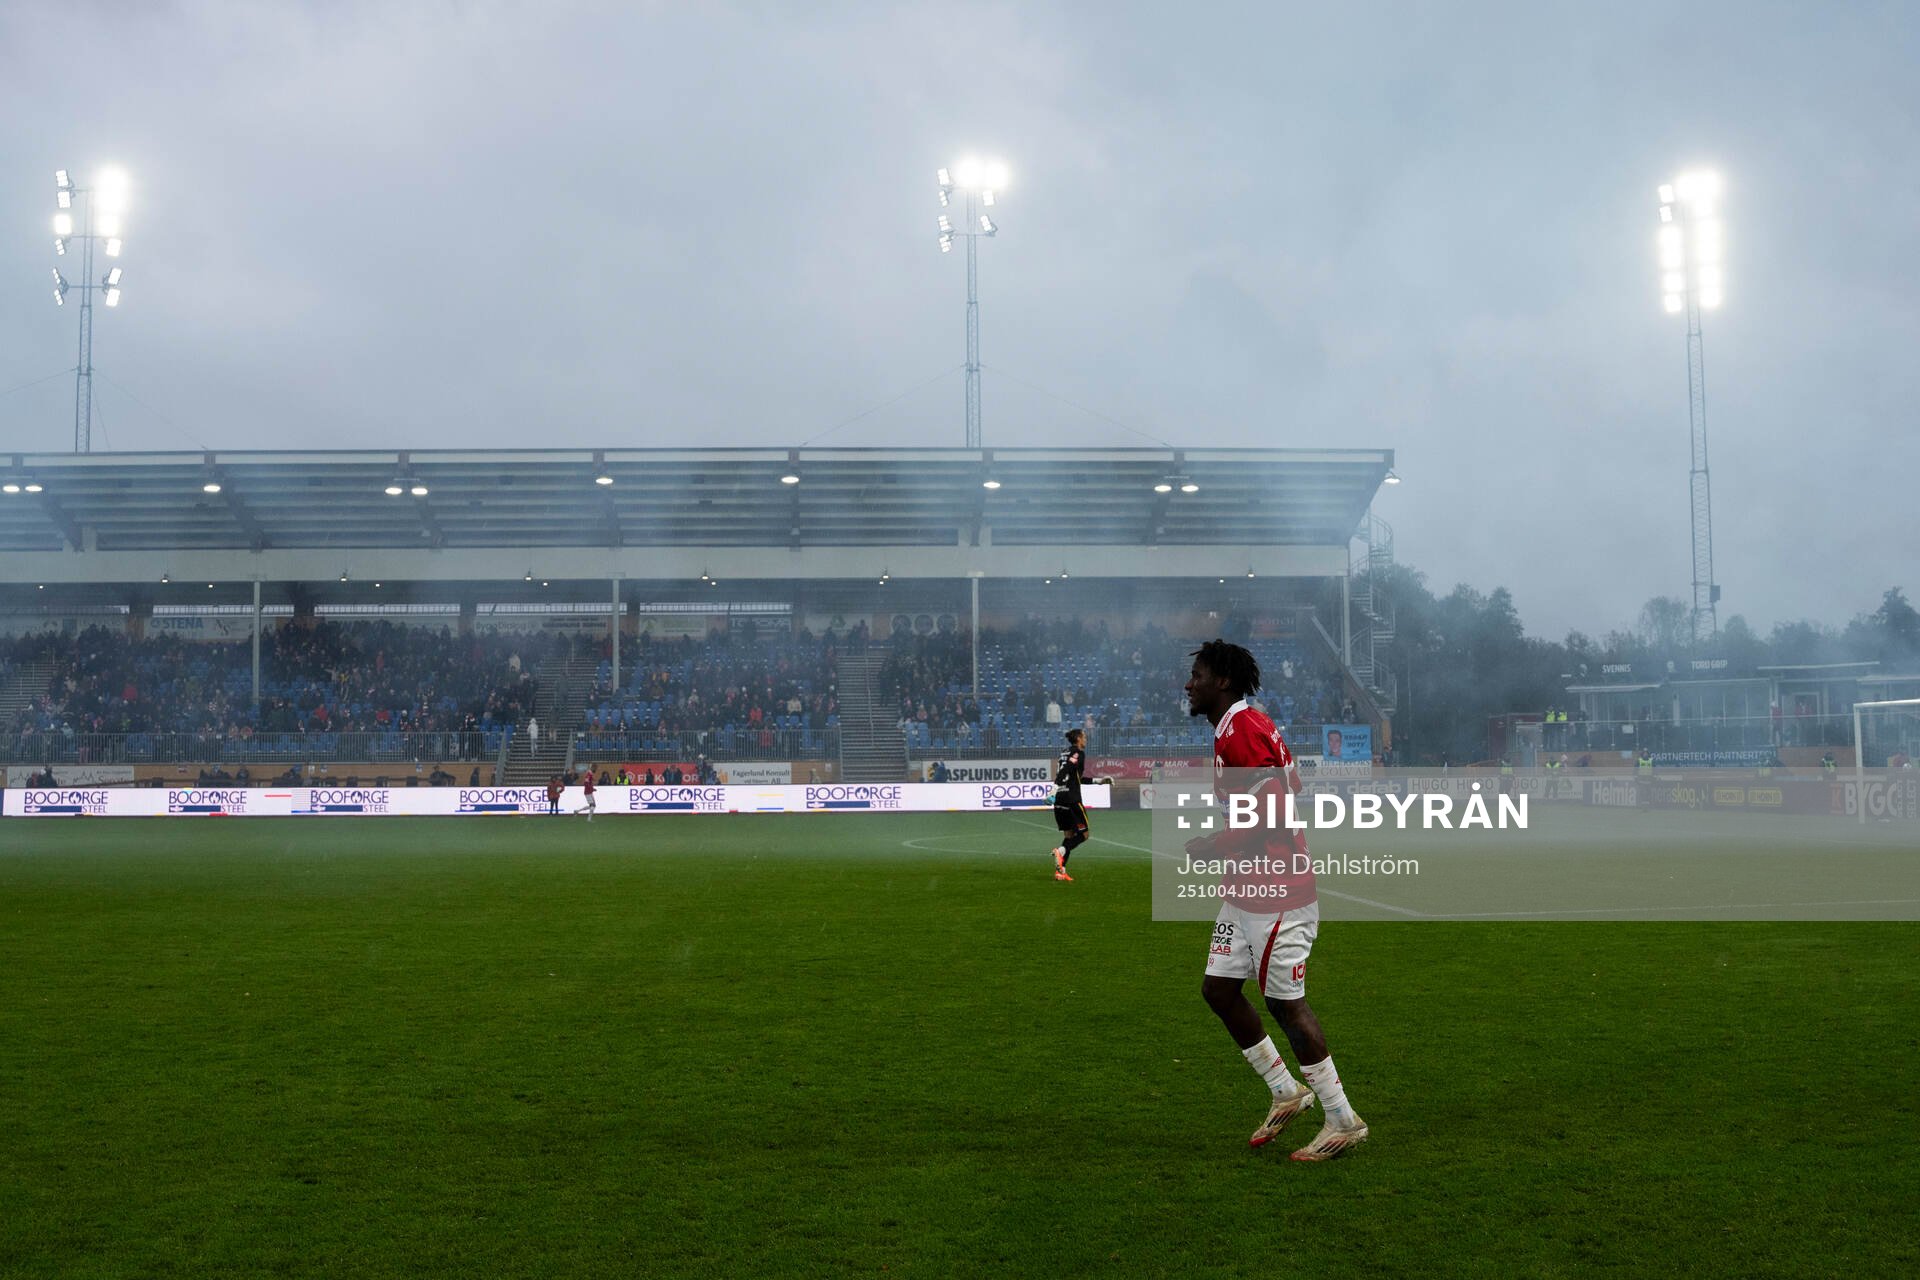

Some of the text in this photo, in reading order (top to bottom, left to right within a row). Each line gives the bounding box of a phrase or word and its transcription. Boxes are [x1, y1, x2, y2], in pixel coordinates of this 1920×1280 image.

[1602, 663, 1632, 674] SVENNIS
[1651, 752, 1711, 762] PARTNERTECH
[1164, 760, 1190, 768] MARK
[733, 769, 765, 778] Fagerlund
[945, 767, 1047, 782] ASPLUNDS BYGG
[1165, 769, 1180, 777] TAK
[1321, 767, 1370, 777] GOLV AB
[1300, 781, 1339, 796] efab
[1346, 780, 1401, 795] defab
[1512, 778, 1539, 790] UGO
[24, 791, 109, 805] BOOFORGE
[168, 790, 247, 804] BOOFORGE
[310, 790, 389, 804] BOOFORGE
[629, 788, 725, 801] BOOFORGE
[806, 786, 902, 800] BOOFORGE
[1591, 781, 1637, 806] Helmia
[82, 805, 107, 814] STEEL
[220, 804, 247, 813] STEEL
[363, 804, 389, 813] STEEL
[519, 803, 549, 812] STEEL
[693, 801, 725, 811] STEEL
[870, 800, 901, 809] STEEL
